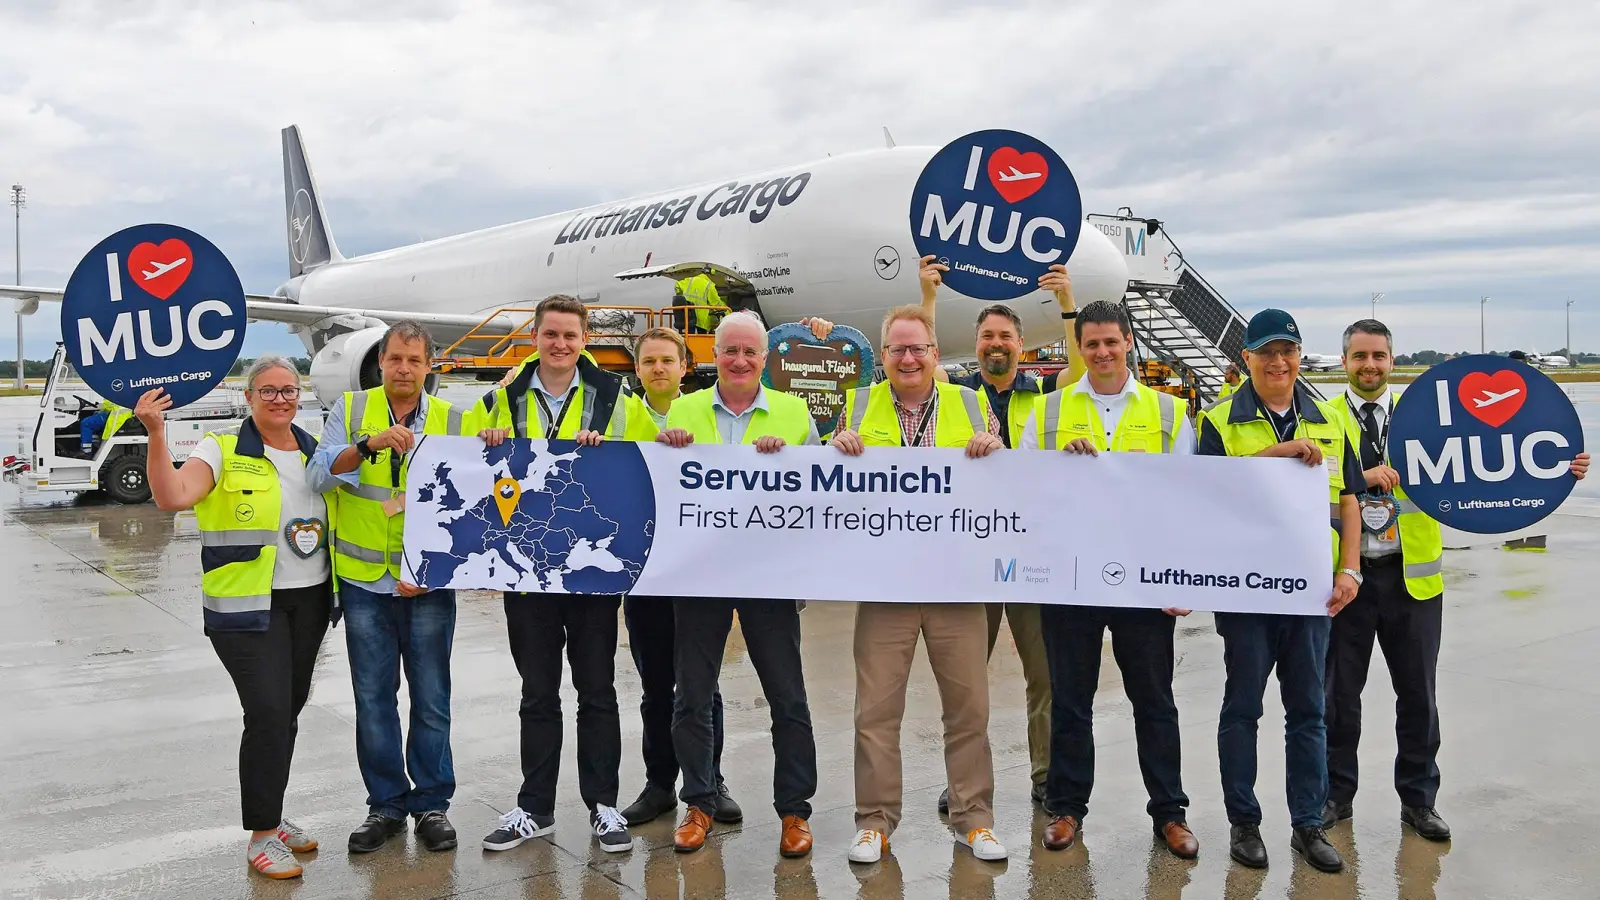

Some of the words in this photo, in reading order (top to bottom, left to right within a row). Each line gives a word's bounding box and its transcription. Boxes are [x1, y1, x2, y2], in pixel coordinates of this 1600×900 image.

[963, 145, 984, 191] I
[553, 195, 698, 246] Lufthansa
[696, 172, 812, 224] Cargo
[919, 193, 1066, 263] MUC
[106, 252, 123, 302] I
[762, 266, 791, 279] CityLine
[954, 261, 999, 279] Lufthansa
[1000, 271, 1029, 286] Cargo
[755, 287, 772, 296] rhaba
[772, 285, 794, 296] Türkiye
[77, 299, 235, 367] MUC
[129, 374, 179, 389] Lufthansa
[180, 370, 212, 382] Cargo
[780, 358, 827, 377] Inaugural
[826, 359, 856, 379] Flight
[812, 405, 833, 418] 2024
[1435, 379, 1452, 427] I
[1404, 430, 1572, 486] MUC
[679, 460, 802, 492] Servus
[811, 464, 952, 494] Munich!
[1458, 500, 1510, 510] Lufthansa
[1512, 497, 1546, 508] Cargo
[678, 502, 739, 530] First
[745, 505, 815, 530] A321
[822, 506, 943, 538] freighter
[950, 507, 1027, 540] flight.
[1025, 575, 1049, 584] Airport
[1139, 566, 1240, 588] Lufthansa
[1245, 571, 1308, 594] Cargo
